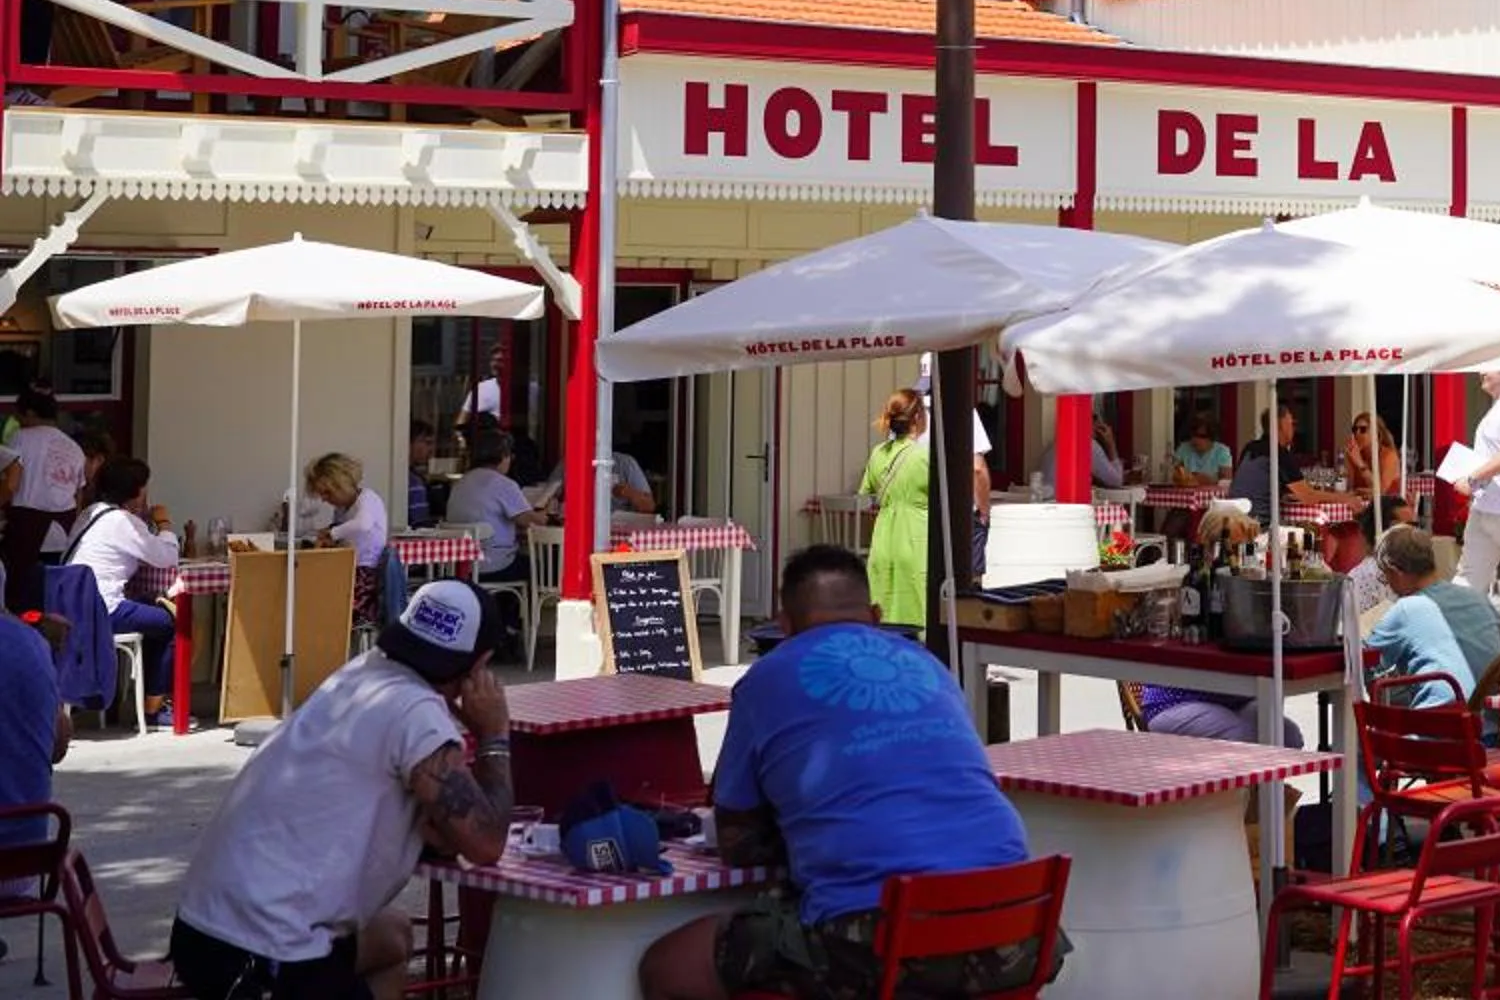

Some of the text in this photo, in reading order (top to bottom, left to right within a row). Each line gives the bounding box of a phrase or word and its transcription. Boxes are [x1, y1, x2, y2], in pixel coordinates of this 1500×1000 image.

[684, 81, 1019, 167] HOTEL
[1157, 109, 1259, 177] DE
[1297, 118, 1397, 183] LA
[746, 335, 906, 355] HÔTEL DE LA PLAGE
[1211, 348, 1404, 369] HÔTEL DE LA PLAGE
